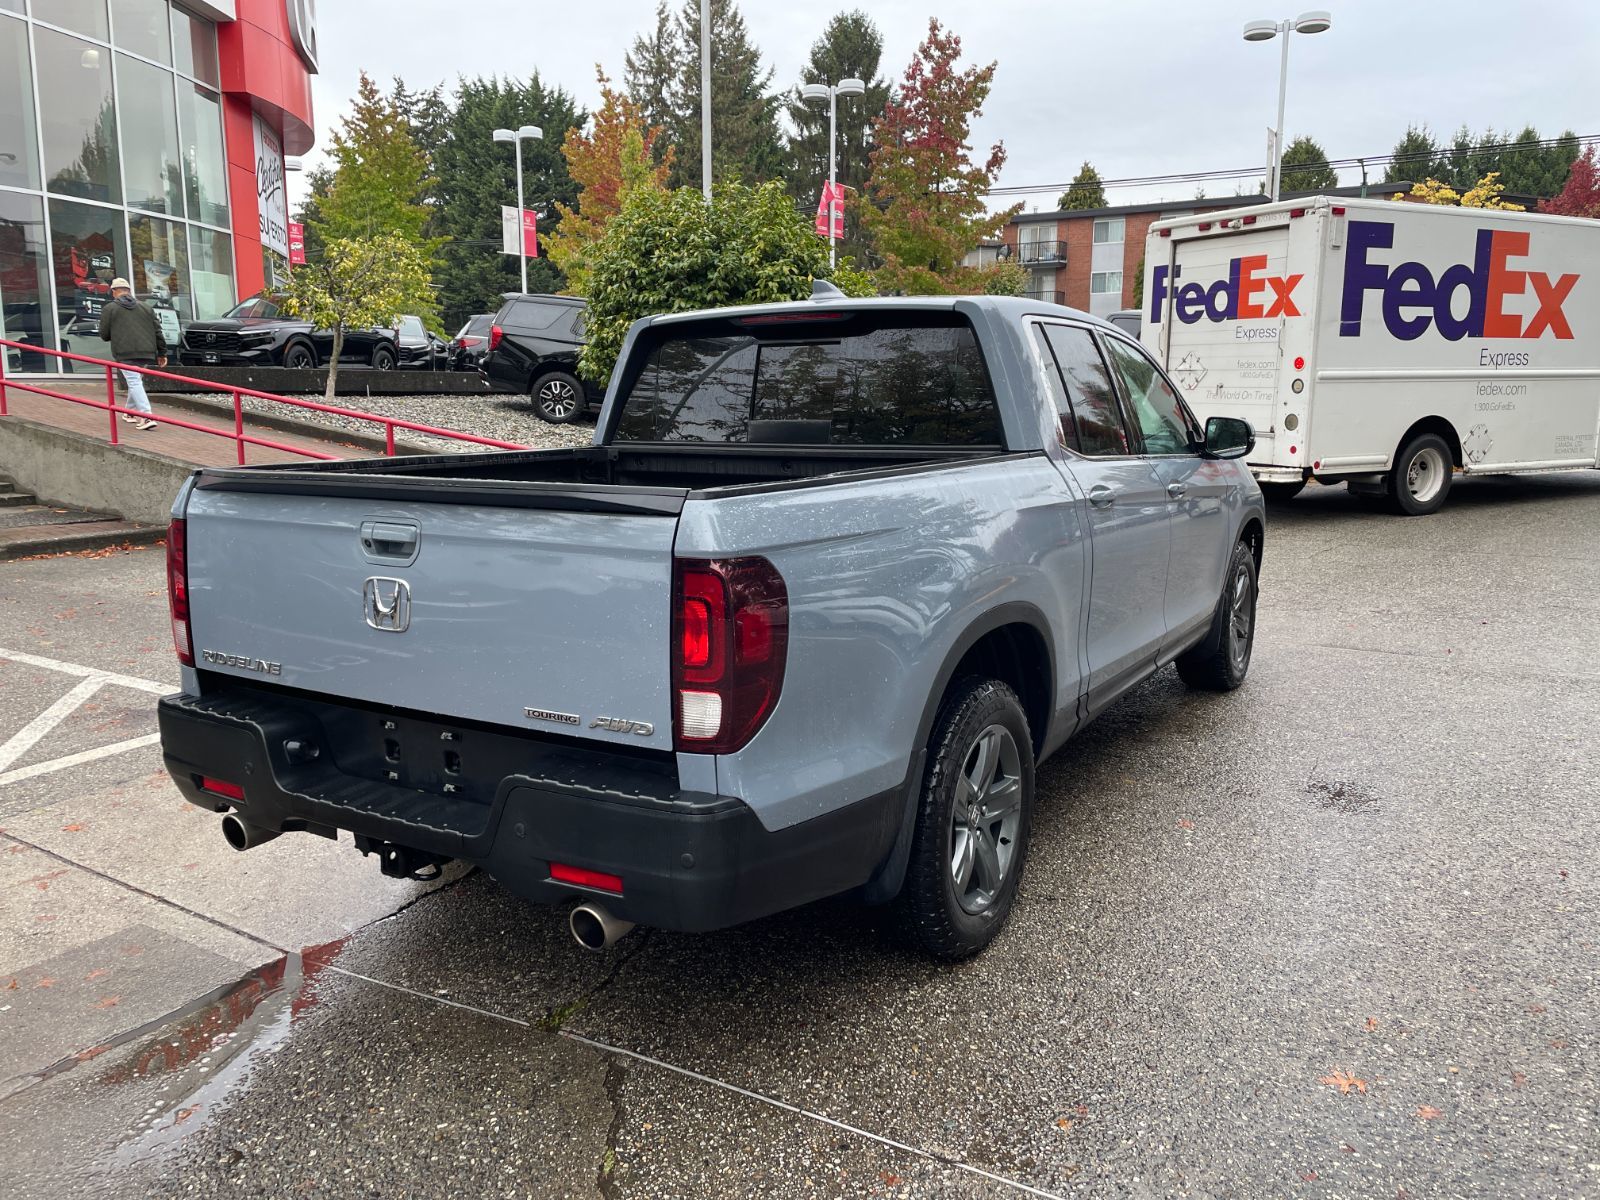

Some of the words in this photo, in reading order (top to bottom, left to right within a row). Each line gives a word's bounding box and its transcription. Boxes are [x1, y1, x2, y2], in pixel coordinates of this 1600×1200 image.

[1150, 254, 1304, 324] FedEx
[1339, 220, 1581, 341] FedEx
[1235, 325, 1278, 341] Express
[1479, 348, 1529, 370] Express
[1475, 381, 1527, 396] fedex.com
[202, 648, 282, 676] RIDGELINE
[525, 706, 579, 725] TOURING
[588, 716, 655, 737] AWD
